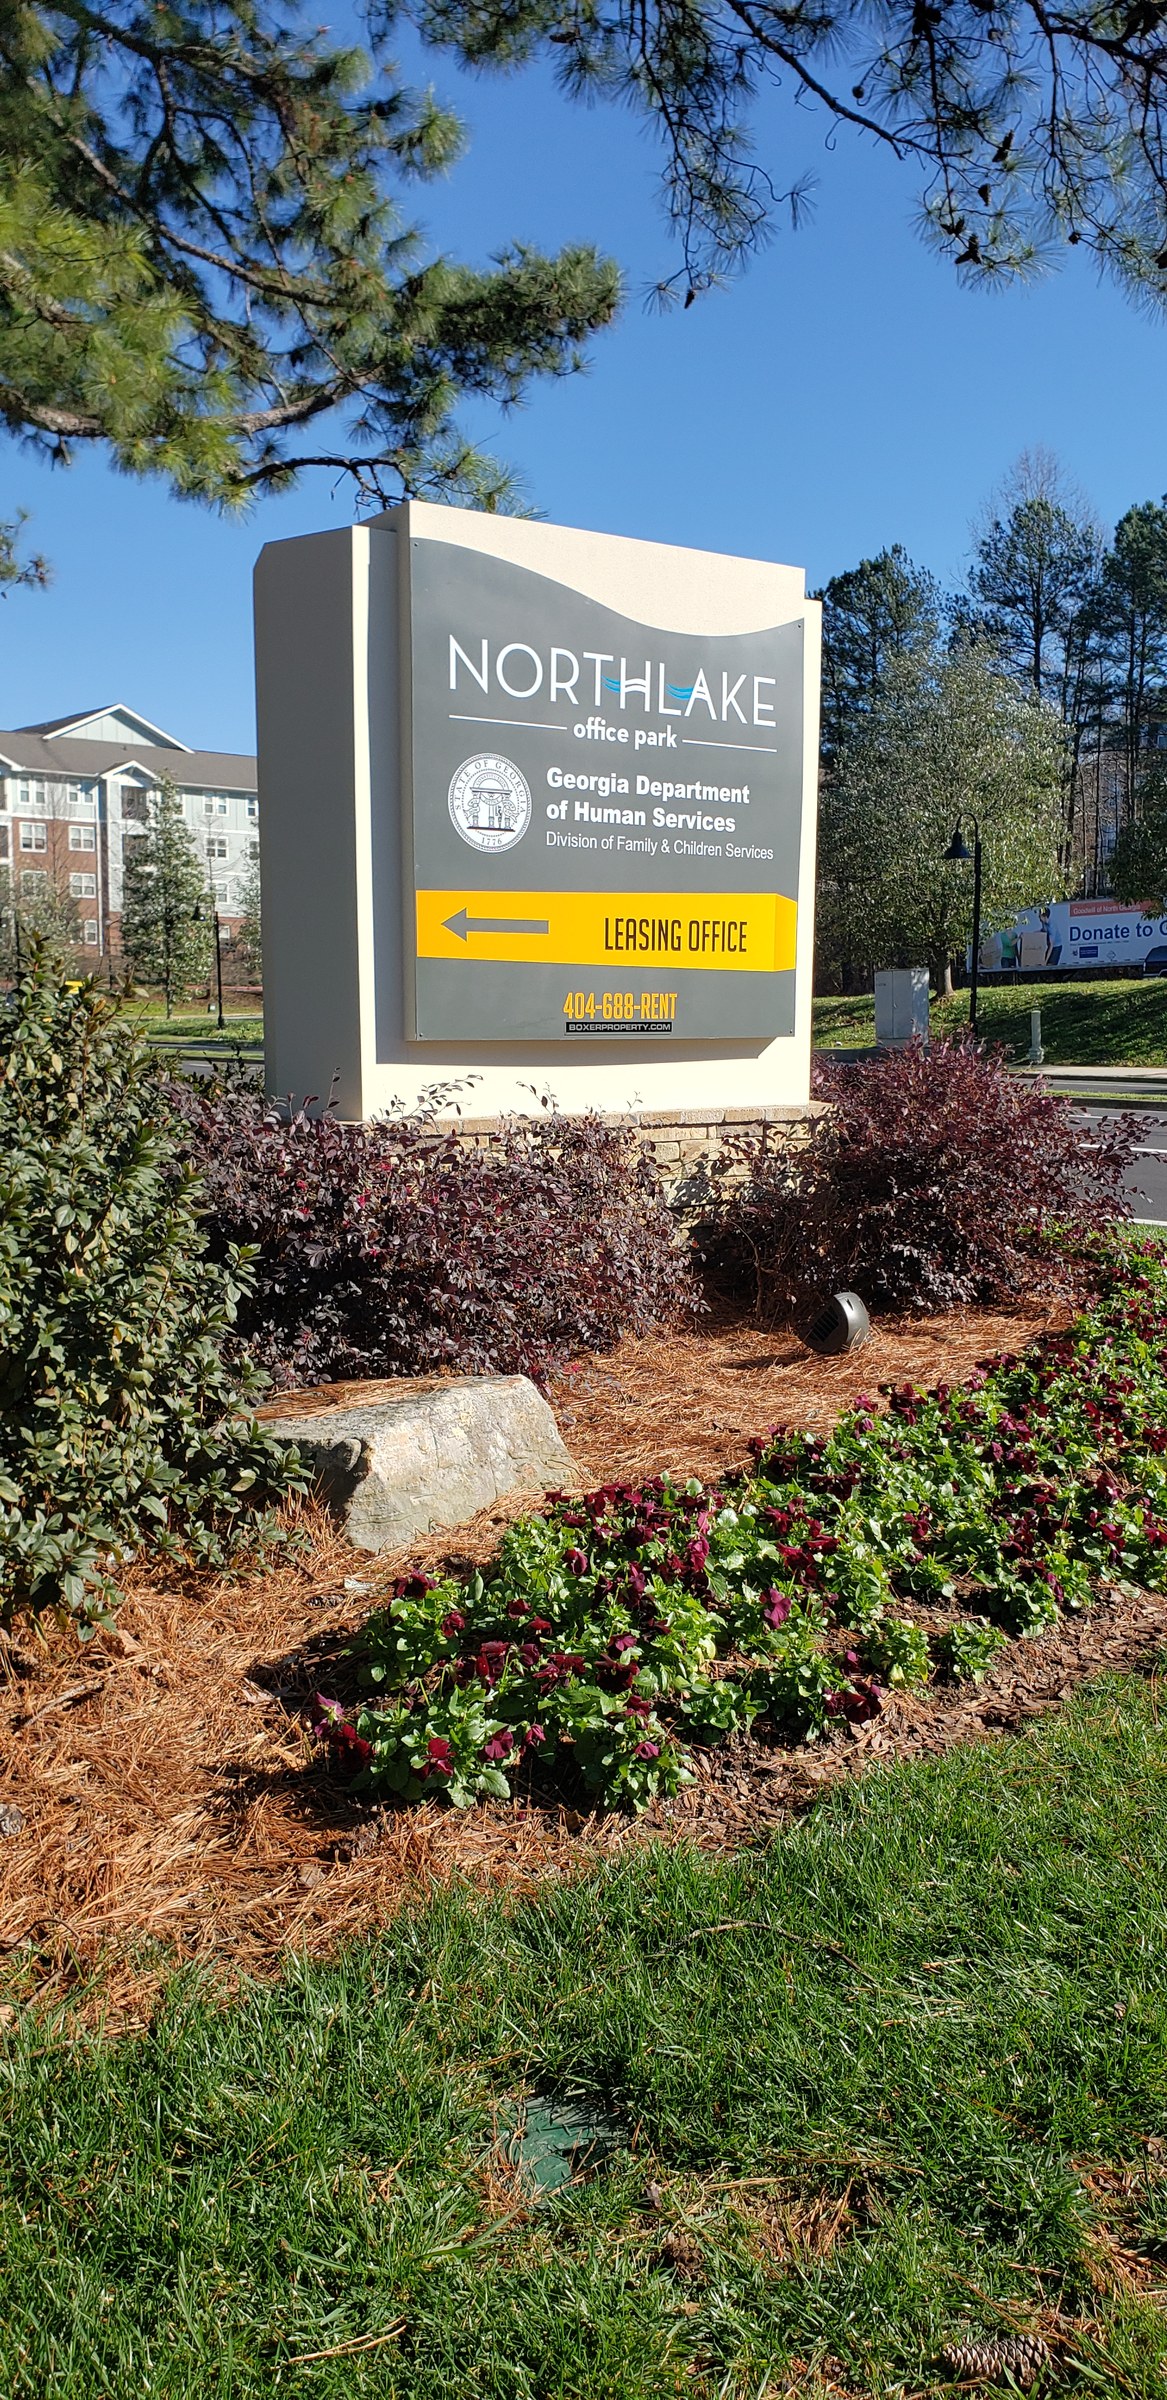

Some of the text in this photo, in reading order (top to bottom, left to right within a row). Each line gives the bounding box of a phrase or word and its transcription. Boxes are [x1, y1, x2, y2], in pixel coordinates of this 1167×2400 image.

[449, 634, 777, 727] NORTHLAKE
[573, 716, 677, 751] office park
[455, 760, 526, 813] STATE OF GEORGIA
[546, 767, 750, 804] Georgia Department
[546, 800, 736, 833] of Human Services
[481, 837, 503, 846] 1776
[546, 831, 774, 860] Division of Family & Children Services
[605, 917, 748, 953] LEASING OFFICE
[1070, 924, 1130, 942] Donate
[1136, 923, 1153, 937] to
[563, 992, 678, 1020] 404-688-RENT
[568, 1023, 671, 1032] BOXERPROPERTY.COM
